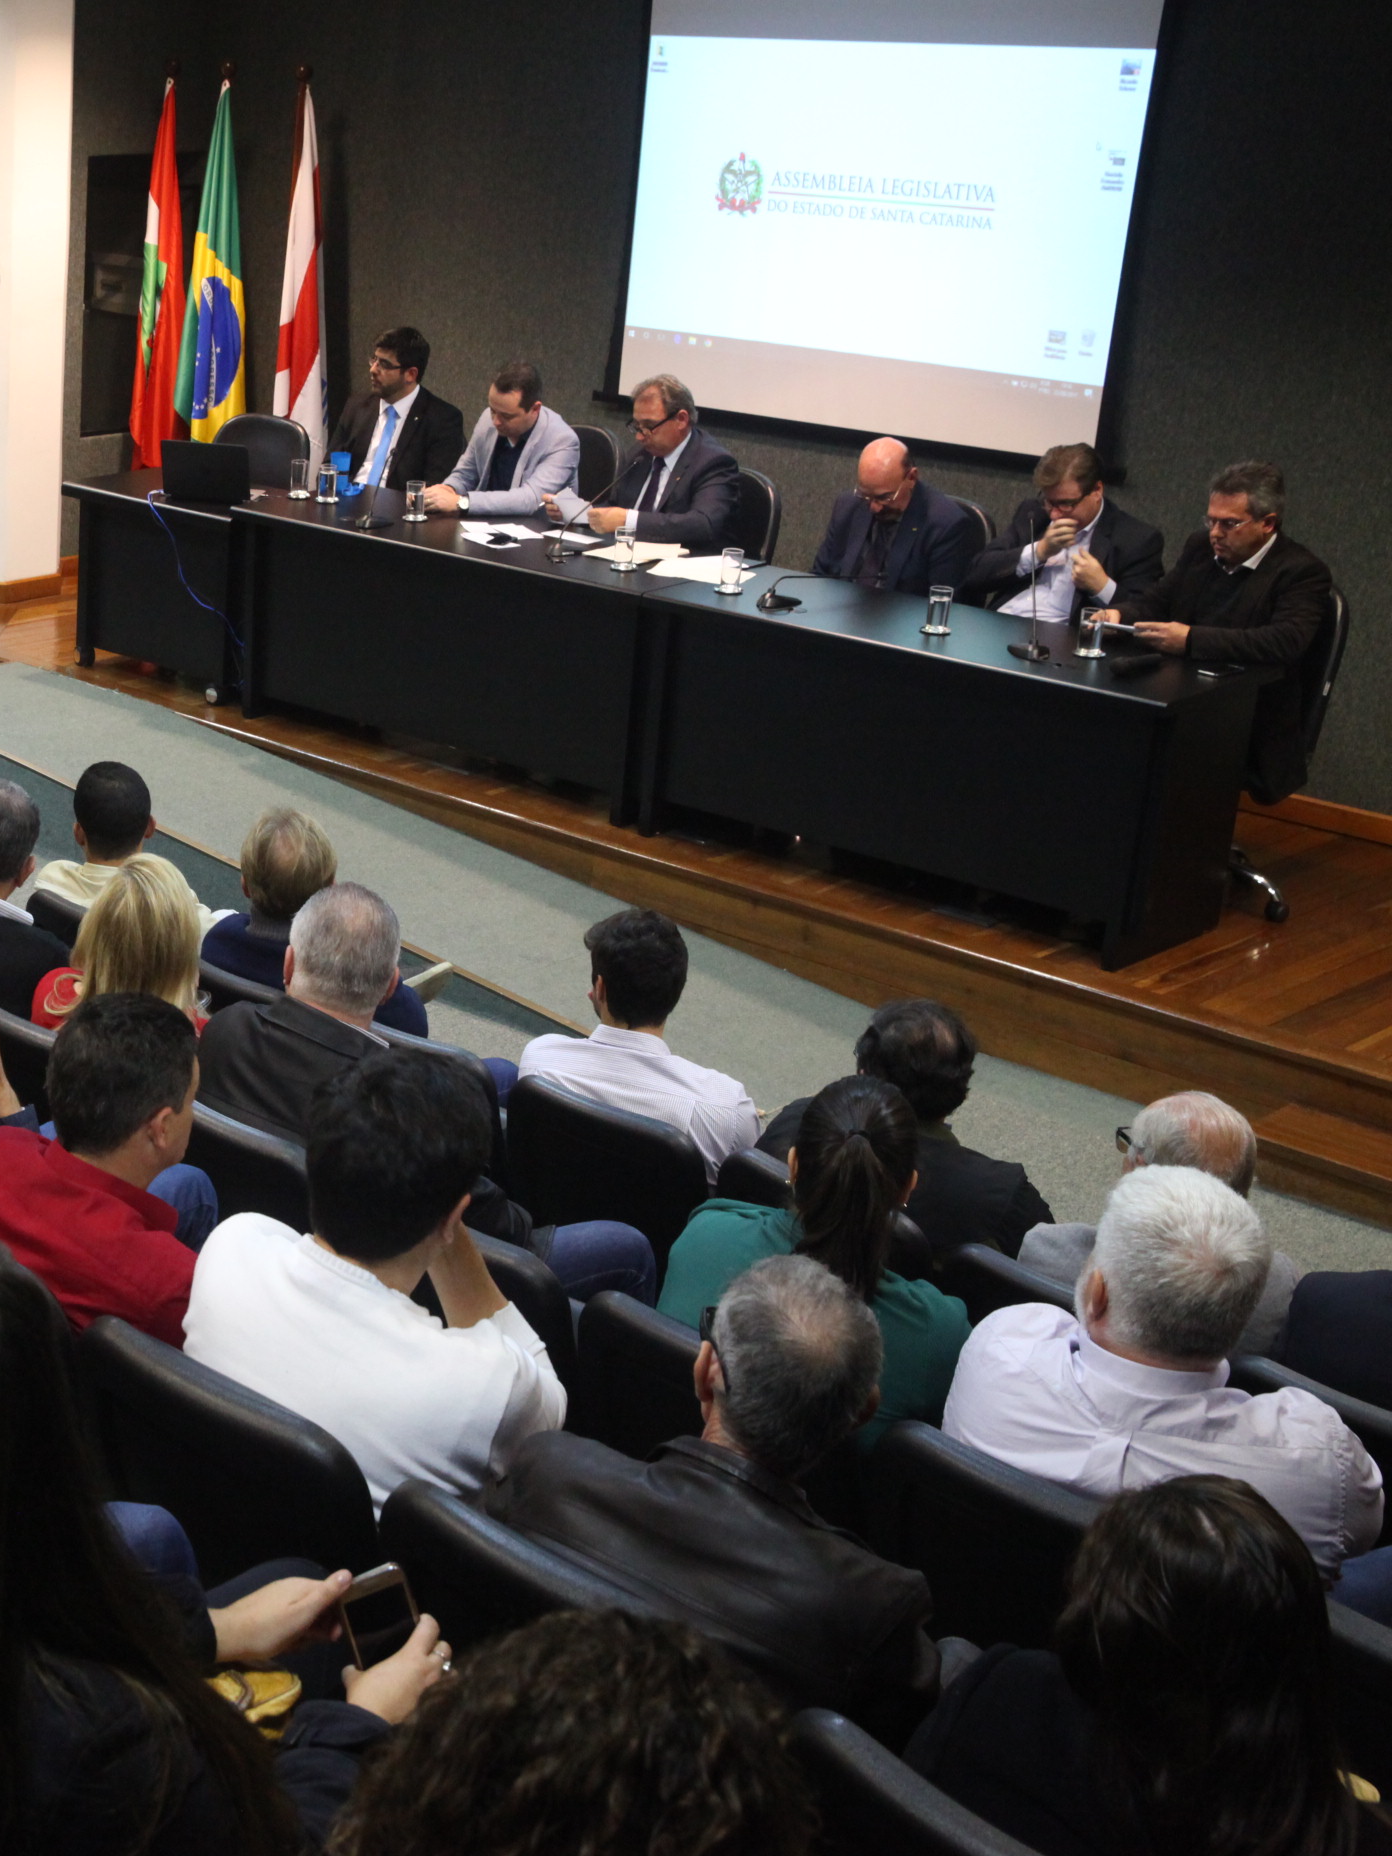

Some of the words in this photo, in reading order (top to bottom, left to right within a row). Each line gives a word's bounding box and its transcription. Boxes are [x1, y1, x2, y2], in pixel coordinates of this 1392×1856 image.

[770, 170, 875, 194] ASSEMBLEIA
[881, 178, 996, 203] LEGISLATIVA
[767, 199, 788, 213] DO
[792, 200, 844, 217] ESTADO
[848, 205, 866, 220] DE
[870, 207, 915, 224] SANTA
[919, 211, 992, 230] CATARINA
